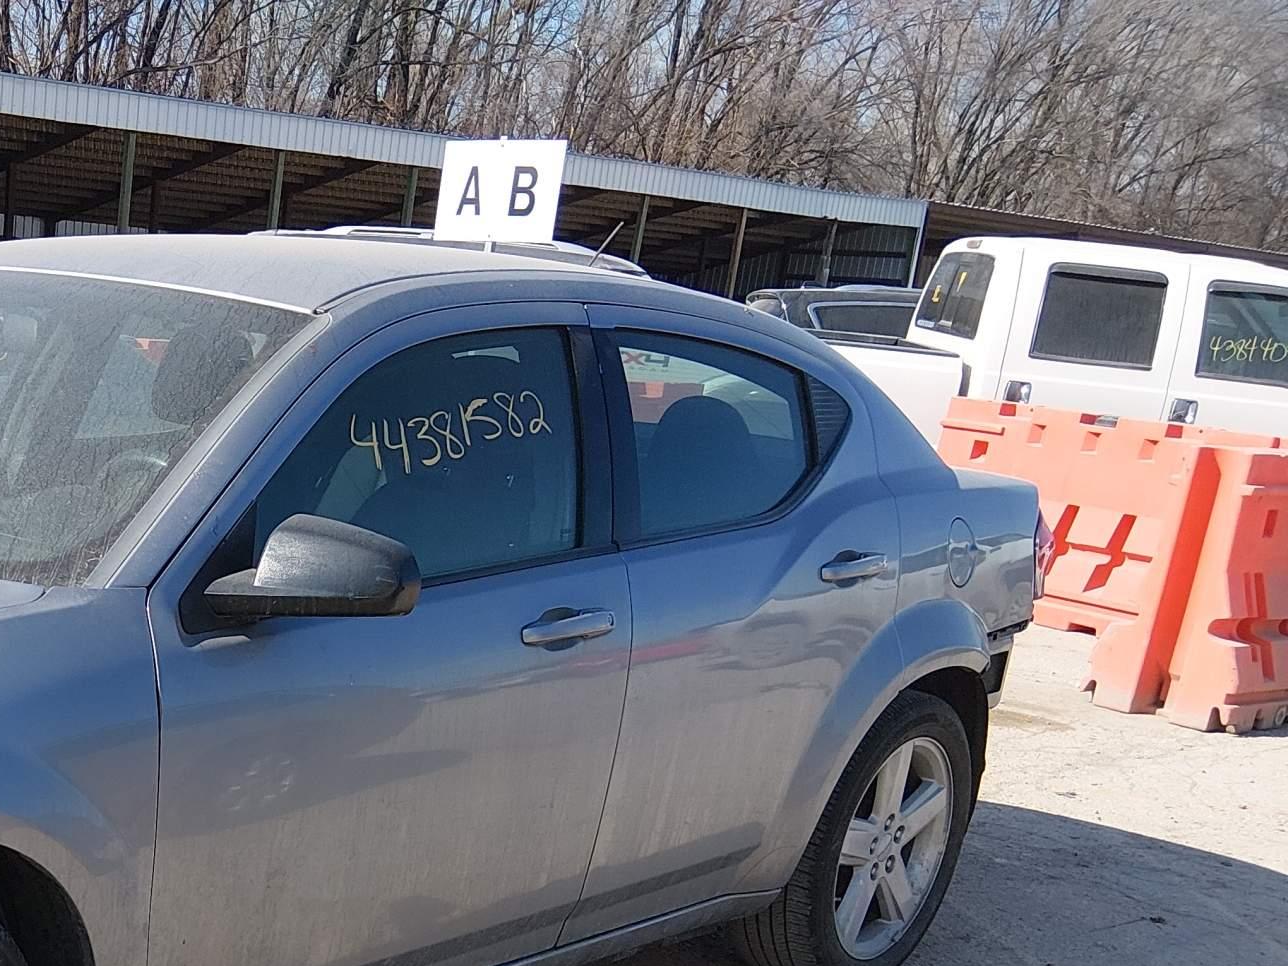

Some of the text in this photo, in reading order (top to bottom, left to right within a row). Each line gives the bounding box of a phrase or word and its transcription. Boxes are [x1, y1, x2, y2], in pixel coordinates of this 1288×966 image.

[456, 166, 539, 217] A B
[1209, 335, 1288, 362] 438440
[350, 391, 553, 474] 44381582
